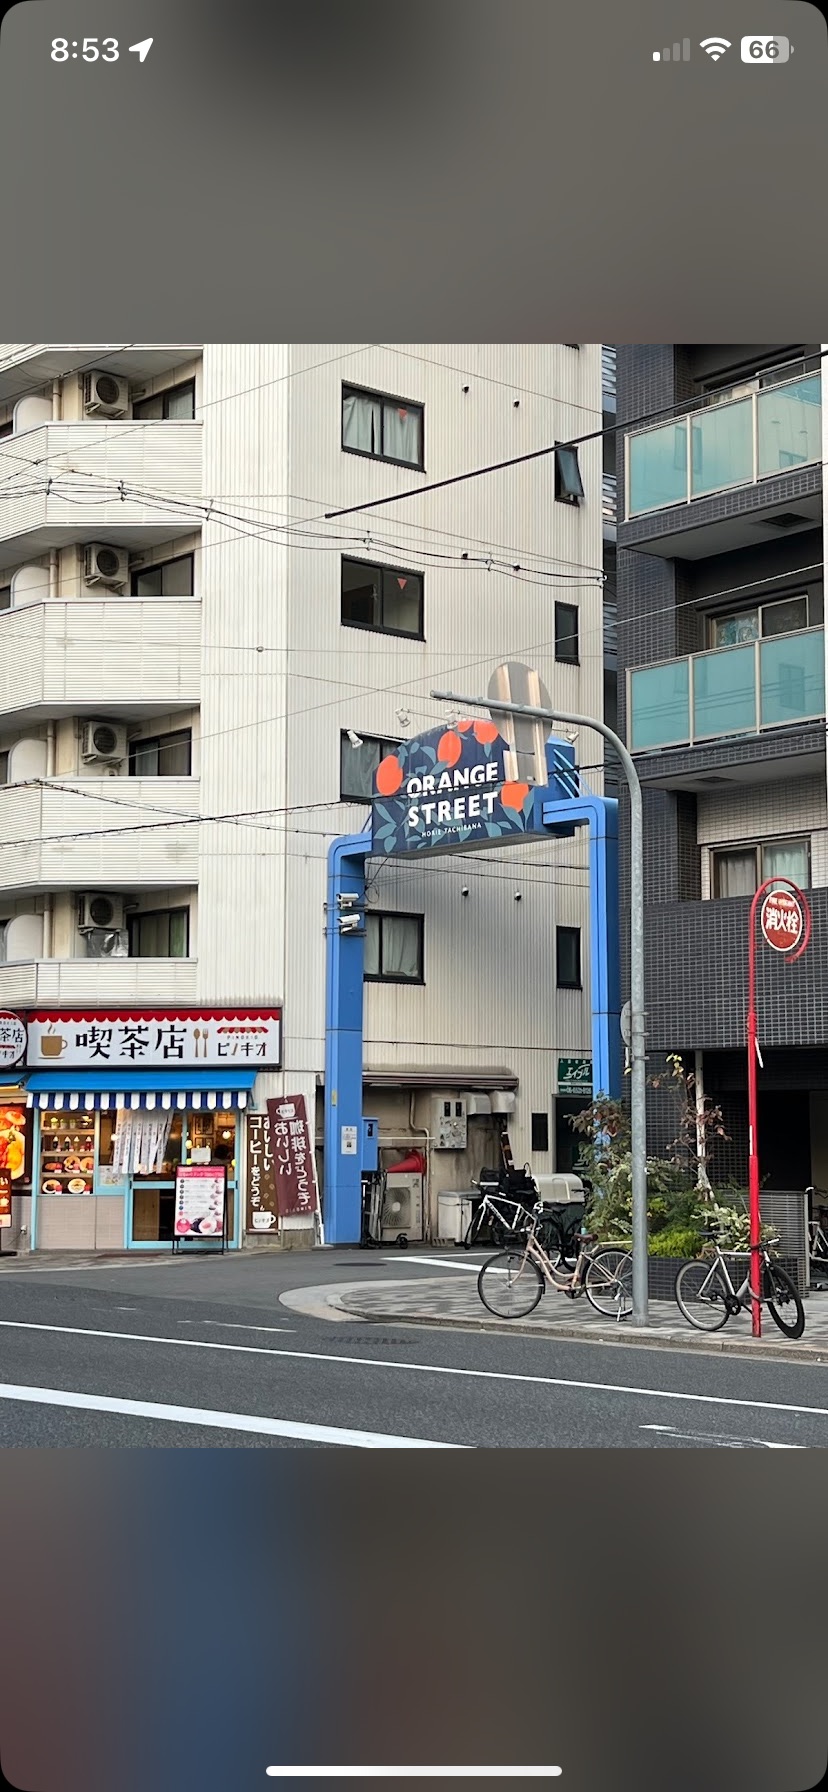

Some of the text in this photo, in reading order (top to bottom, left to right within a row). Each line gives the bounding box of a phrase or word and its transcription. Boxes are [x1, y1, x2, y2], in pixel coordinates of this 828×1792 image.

[406, 761, 499, 799] ORANGE
[408, 791, 499, 828] STREET
[444, 822, 482, 834] TACHIBANA
[765, 906, 799, 935] 消火栓
[75, 1024, 188, 1060] 喫茶店
[217, 1041, 267, 1057] ピノキオ
[249, 1116, 263, 1207] コーヒーをどうぞ
